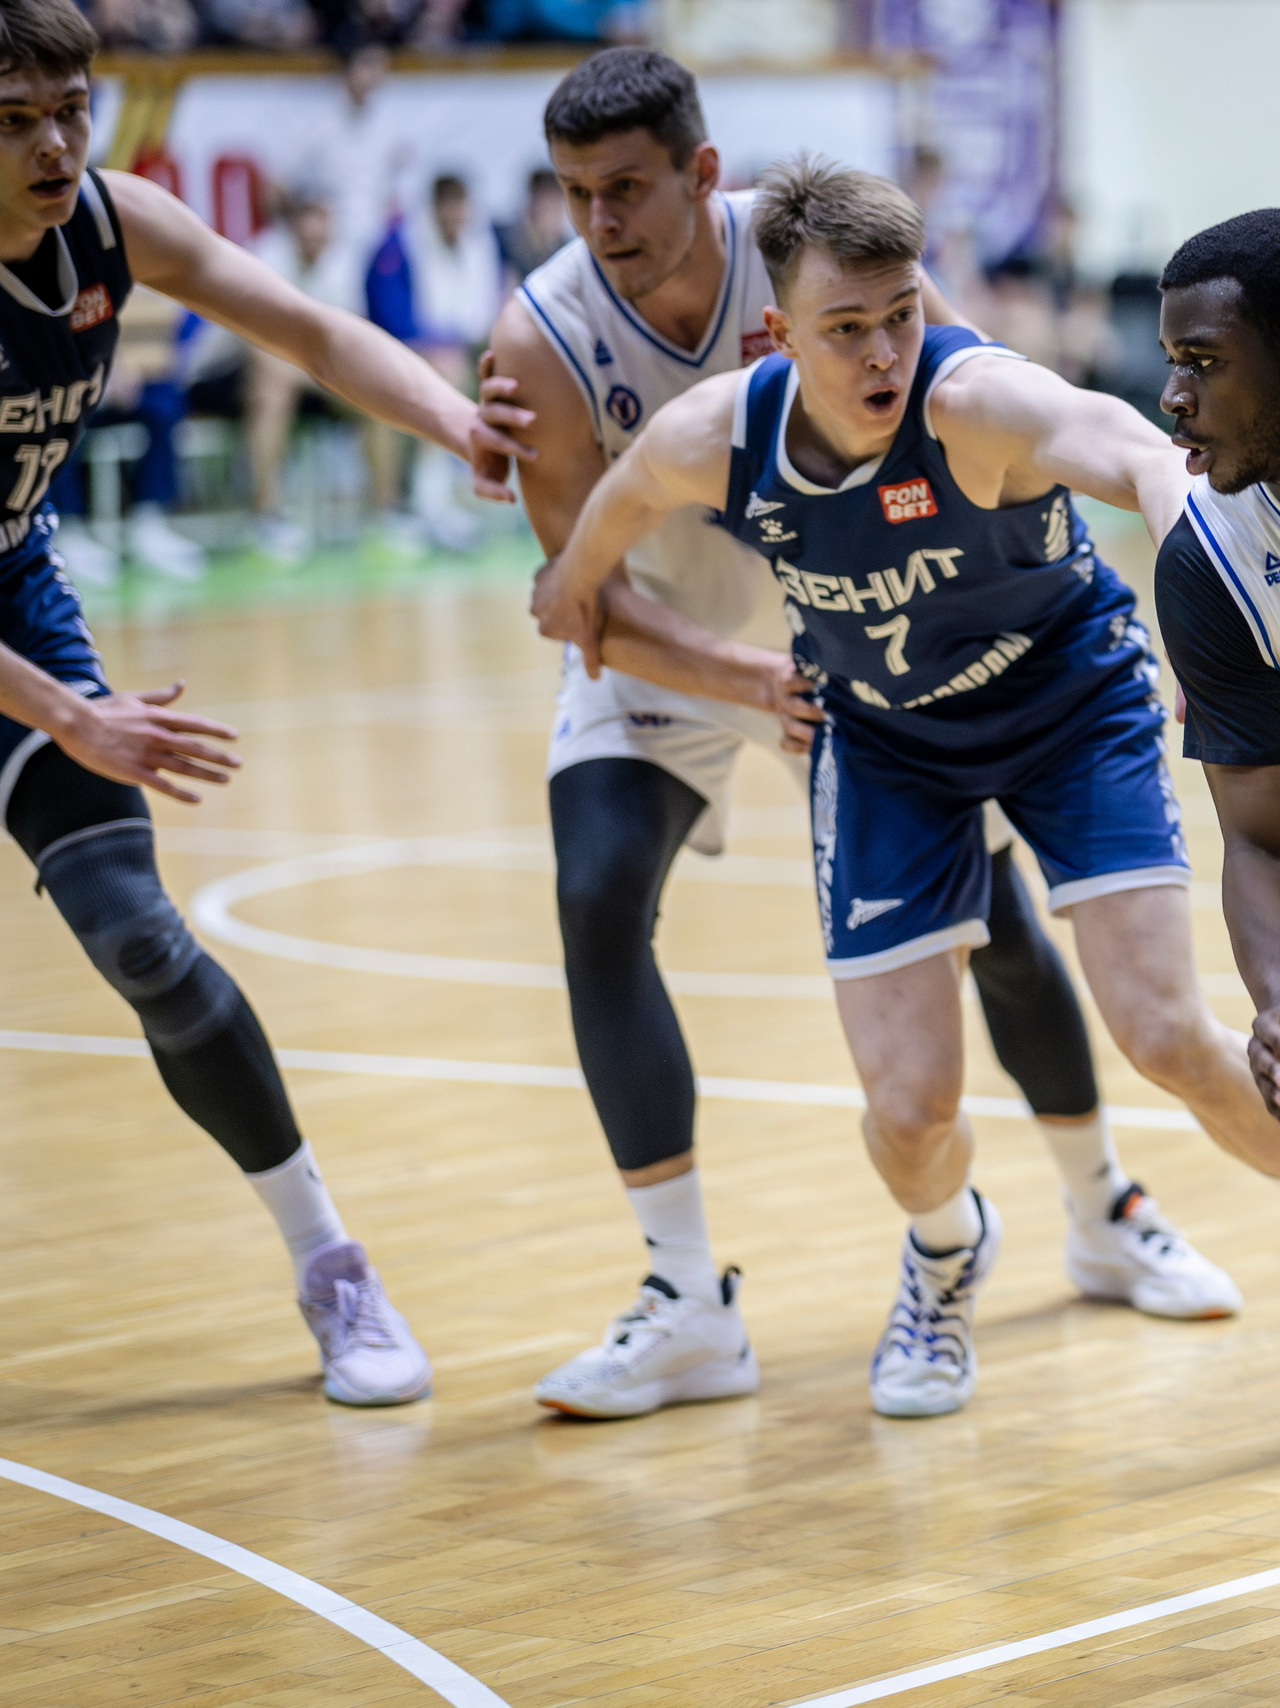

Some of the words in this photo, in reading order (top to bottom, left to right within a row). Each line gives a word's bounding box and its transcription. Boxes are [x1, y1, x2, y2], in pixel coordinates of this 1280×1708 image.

[884, 482, 927, 505] FON
[888, 499, 932, 519] BET
[776, 547, 965, 613] ЗЕНИТ
[864, 613, 911, 676] 7
